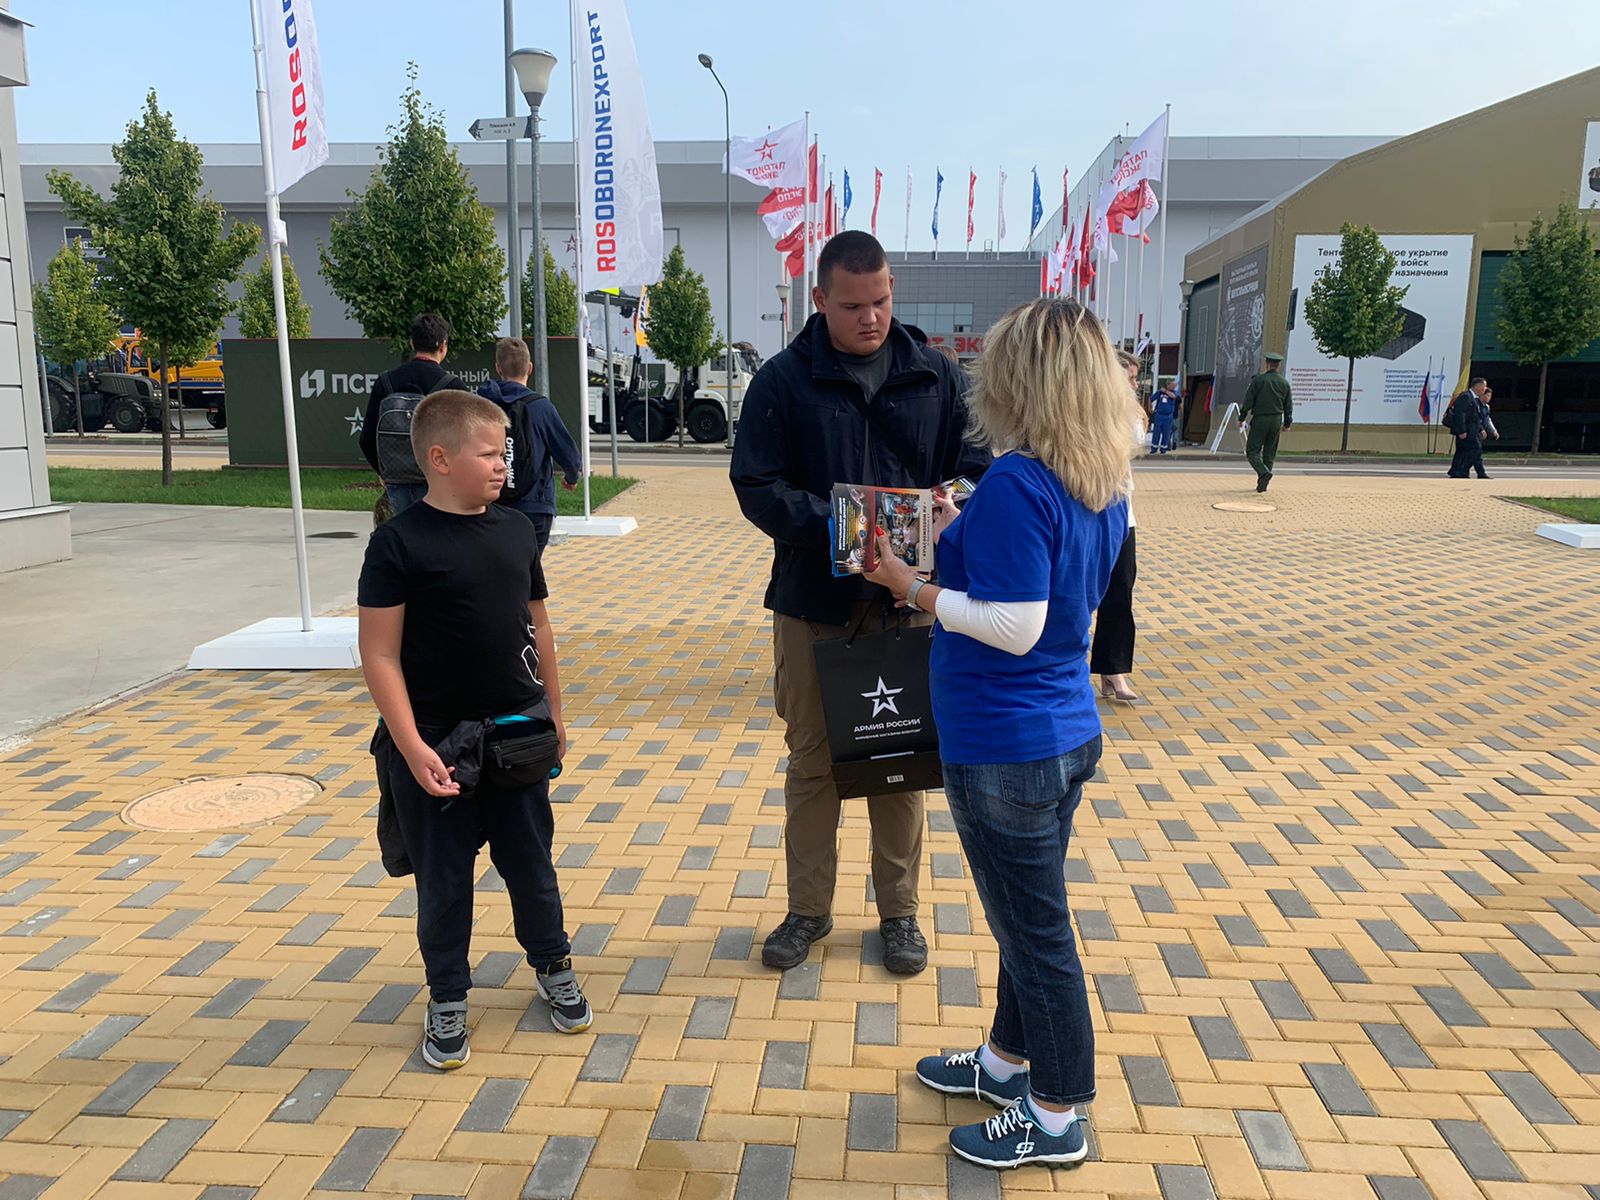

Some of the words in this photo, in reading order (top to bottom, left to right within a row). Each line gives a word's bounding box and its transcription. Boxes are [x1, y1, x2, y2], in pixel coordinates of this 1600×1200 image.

[587, 10, 617, 272] ROSOBORONEXPORT
[1408, 249, 1449, 259] укрытие
[1400, 257, 1429, 267] войск
[854, 722, 885, 733] АРМИЯ
[885, 718, 921, 729] РОССИИ
